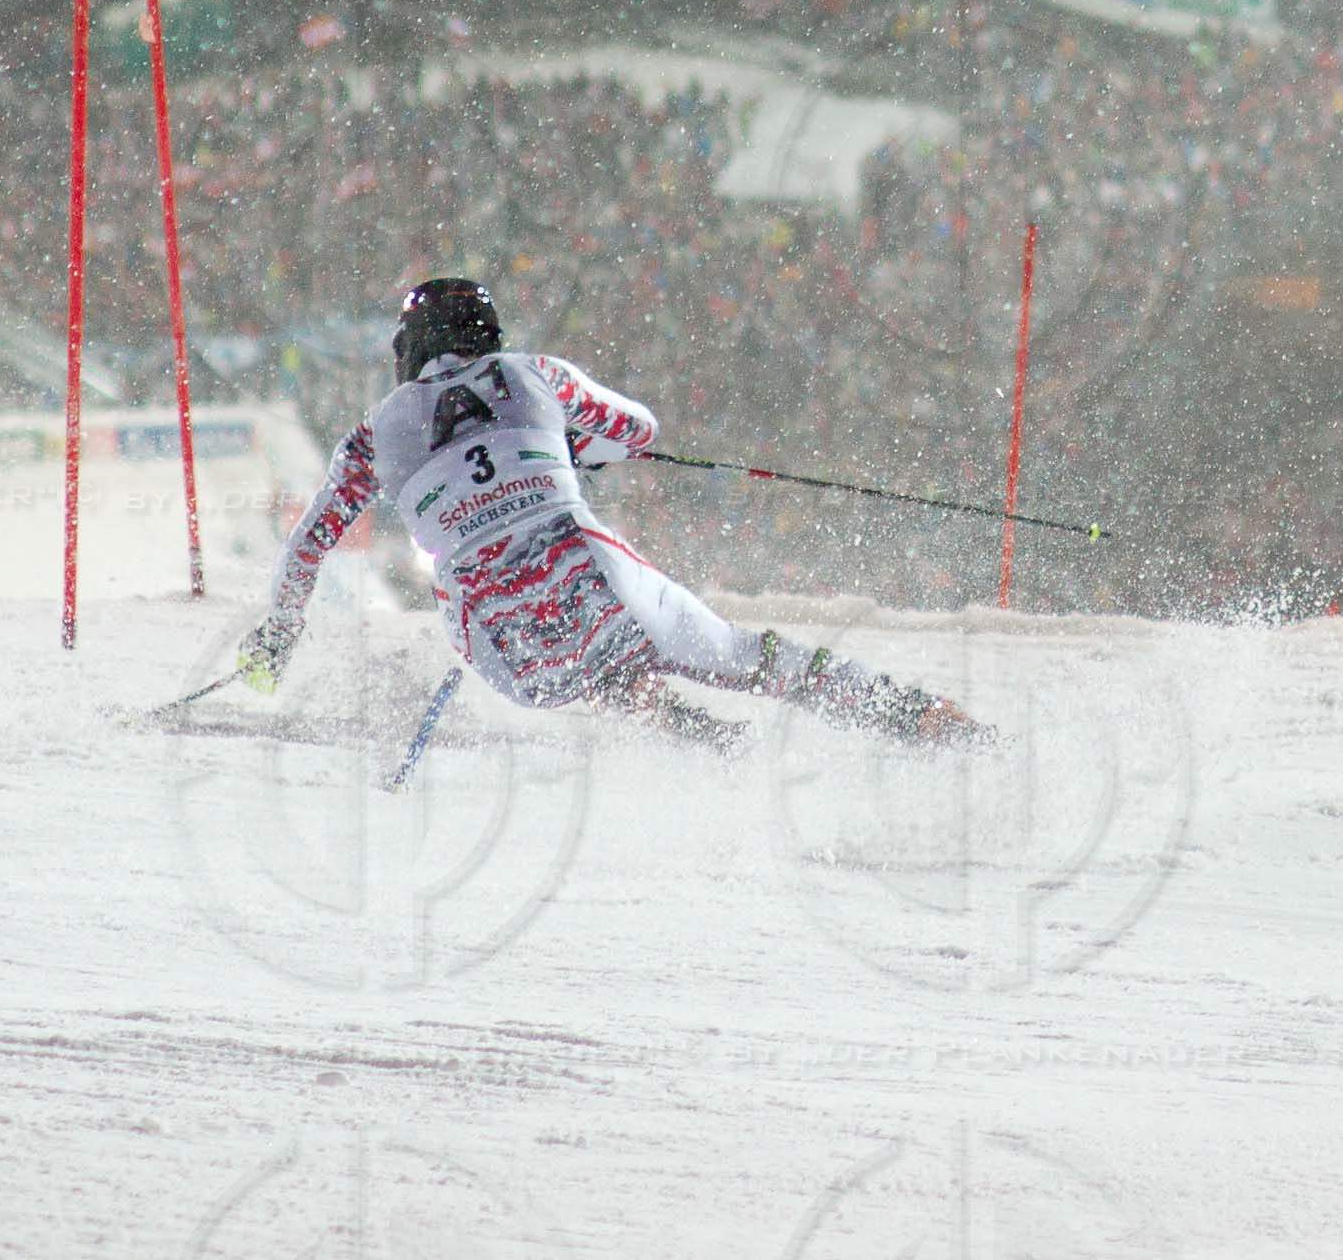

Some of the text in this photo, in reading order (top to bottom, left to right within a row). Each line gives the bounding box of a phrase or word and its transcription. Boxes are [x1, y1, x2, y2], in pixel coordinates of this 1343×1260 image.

[431, 360, 511, 452] A1
[464, 444, 495, 484] 3
[438, 475, 557, 532] Schladming
[458, 492, 546, 538] DACHSTEIN
